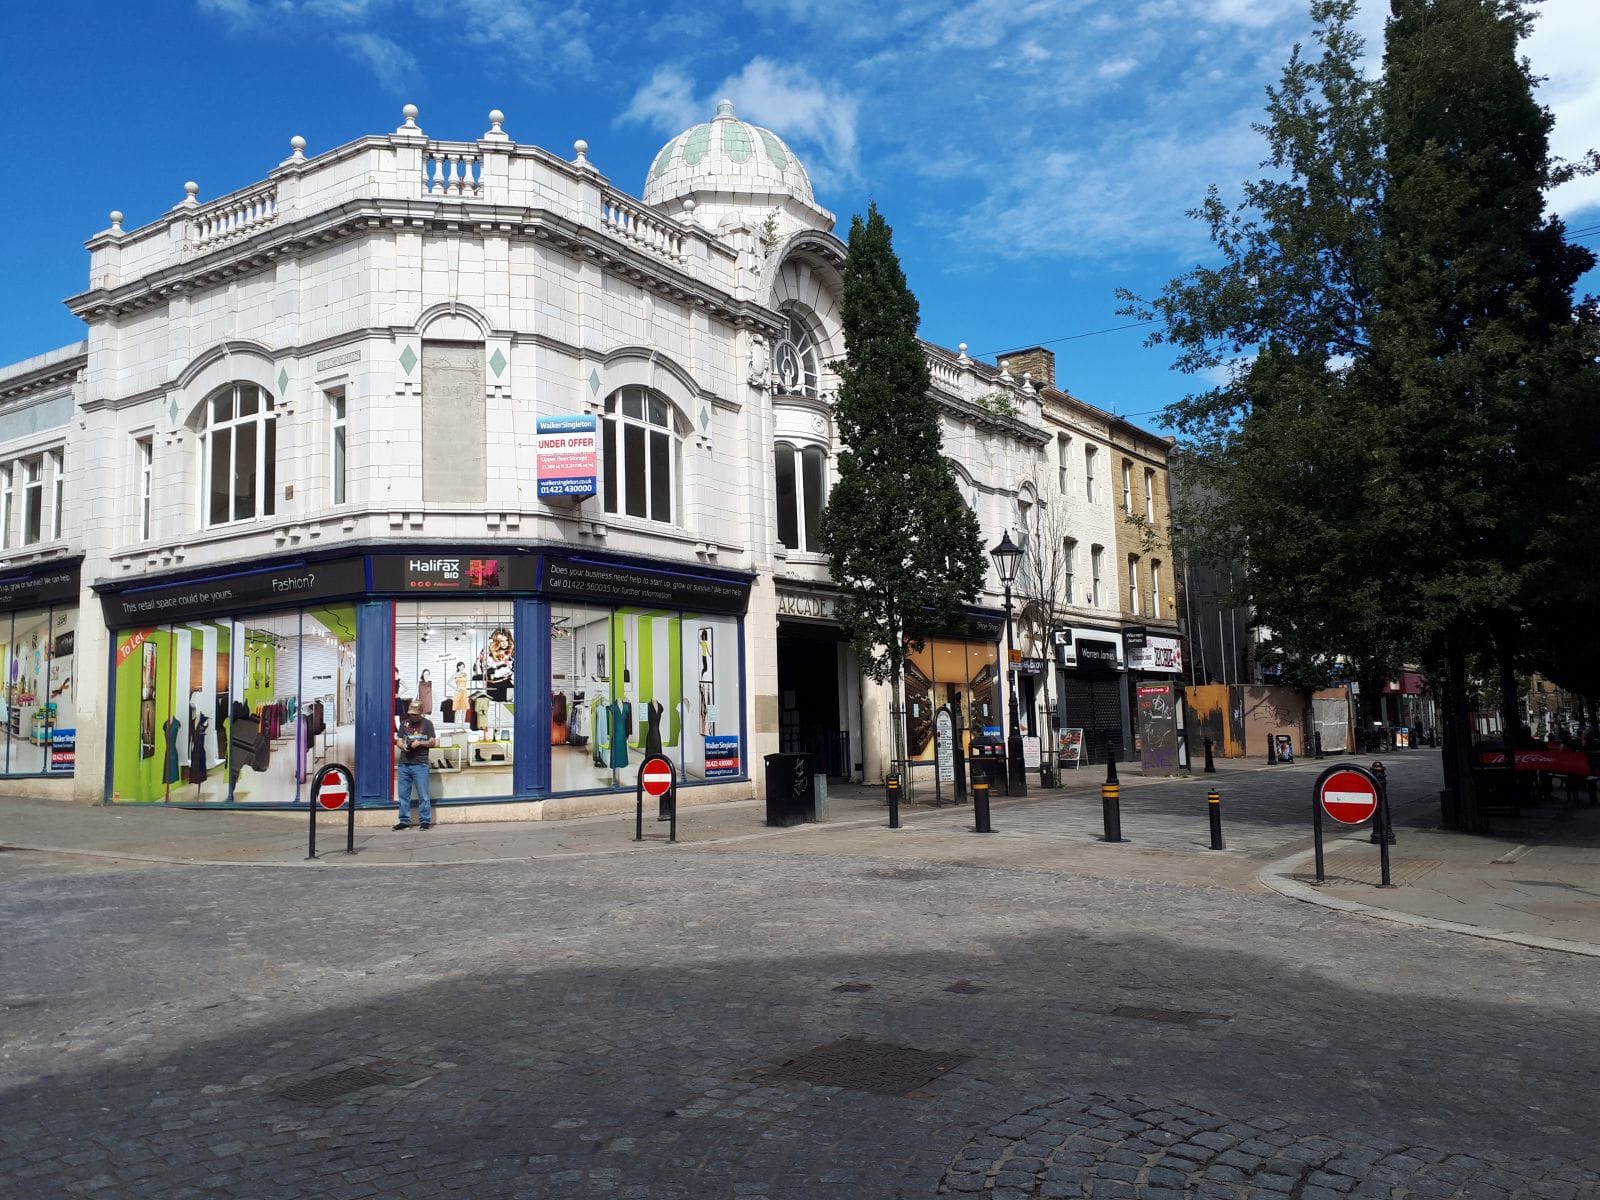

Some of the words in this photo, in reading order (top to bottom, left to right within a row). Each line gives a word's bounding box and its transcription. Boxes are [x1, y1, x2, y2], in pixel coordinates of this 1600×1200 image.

[538, 439, 566, 449] UNDER
[567, 438, 594, 448] OFFER
[541, 486, 563, 494] 01422
[409, 560, 459, 572] Halifax
[272, 573, 315, 593] Fashion?
[549, 578, 561, 587] Call
[562, 579, 585, 590] 01422
[612, 585, 621, 594] for
[621, 586, 641, 596] further
[551, 564, 568, 575] Does
[569, 568, 585, 577] your
[585, 569, 612, 581] business
[613, 573, 629, 582] need
[629, 575, 642, 584] help
[643, 577, 649, 585] to
[650, 578, 663, 587] start
[672, 582, 686, 590] grow
[693, 584, 714, 593] survive?
[122, 602, 138, 613] This
[138, 599, 155, 611] retail
[156, 597, 178, 609] space
[178, 592, 199, 606] could
[199, 592, 210, 602] be
[778, 593, 828, 618] ARCADE
[120, 644, 131, 657] To
[129, 631, 145, 649] Let
[1081, 647, 1100, 659] Warren
[1100, 650, 1115, 661] James
